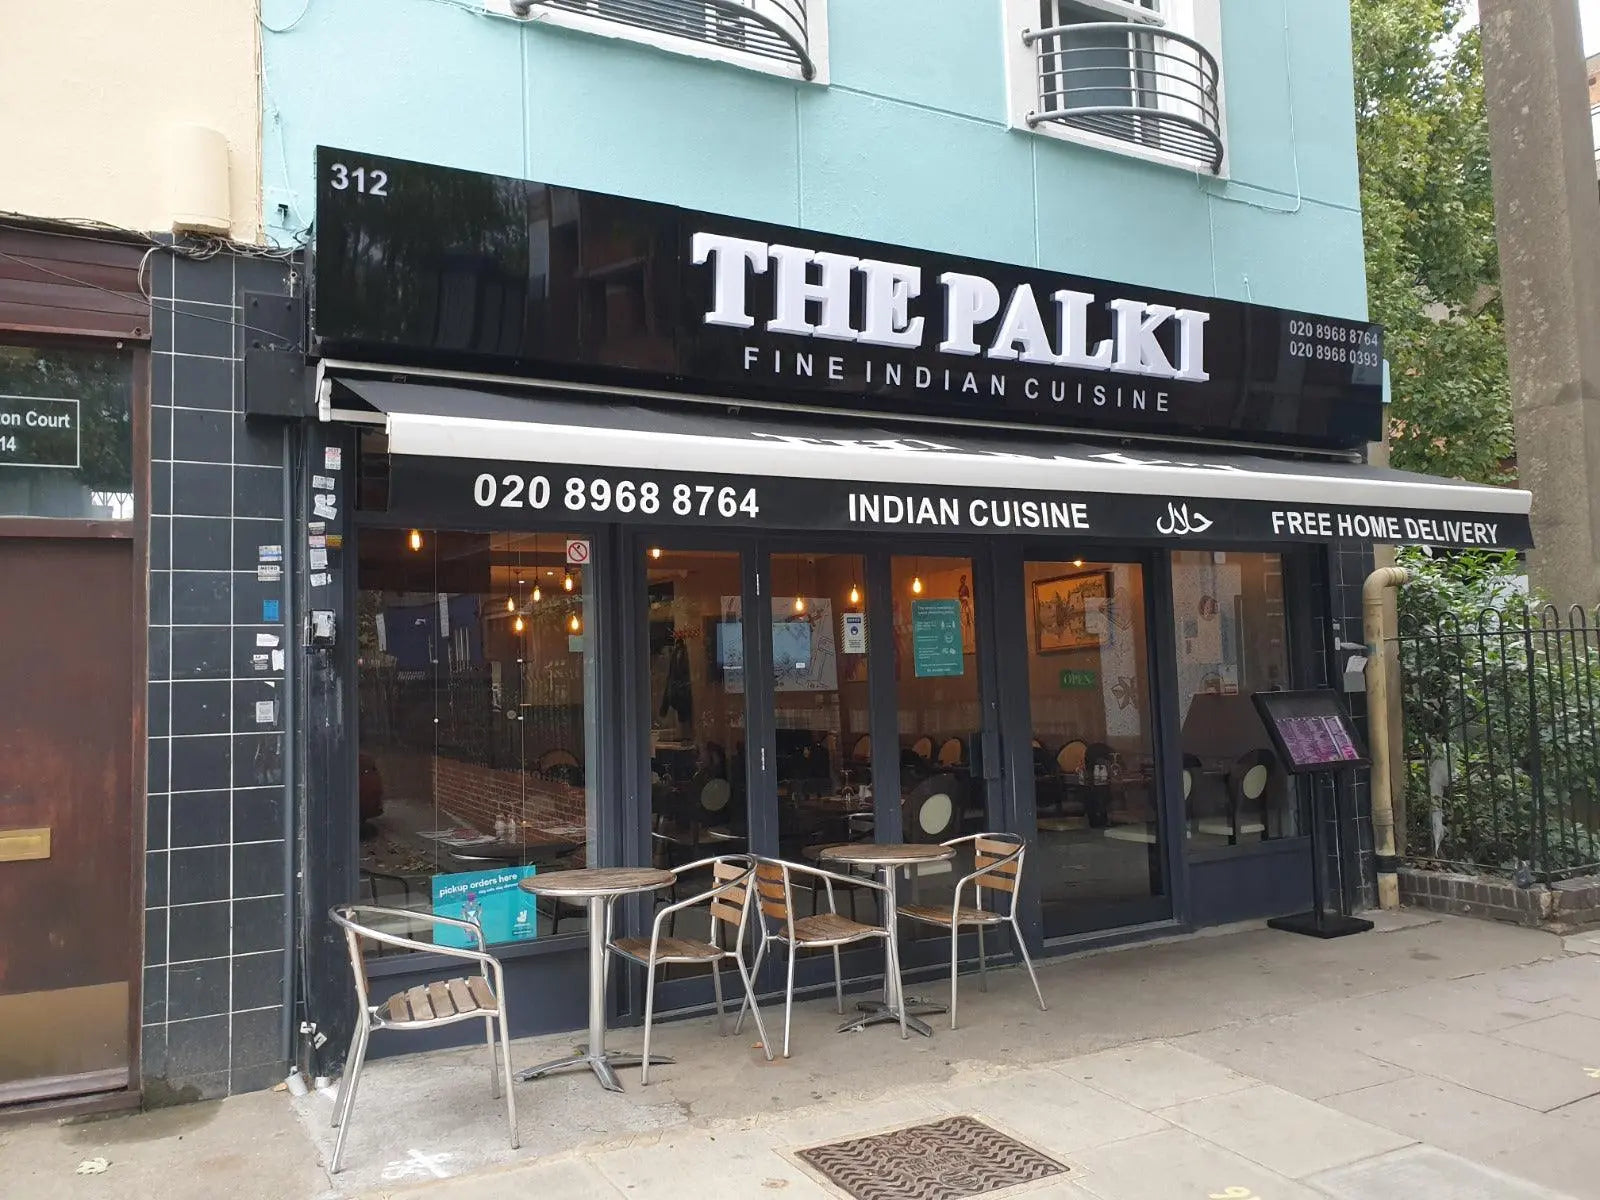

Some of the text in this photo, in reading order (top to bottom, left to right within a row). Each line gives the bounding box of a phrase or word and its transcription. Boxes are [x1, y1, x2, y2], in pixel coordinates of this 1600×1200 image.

[330, 163, 388, 196] 312
[690, 231, 1210, 383] THE PALKI
[1289, 320, 1378, 346] 020 8968 8764
[1289, 341, 1378, 367] 020 8968 0393
[744, 346, 1169, 412] FINE INDIAN CUISINE
[0, 410, 71, 428] on Court
[0, 435, 17, 452] 14
[473, 473, 760, 518] 020 8968 8764
[849, 493, 1090, 530] INDIAN CUISINE
[1155, 501, 1214, 535] حلال
[1271, 511, 1498, 544] FREE HOME DELIVERY
[440, 884, 468, 898] pickup
[470, 879, 498, 889] orders
[498, 873, 518, 883] here
